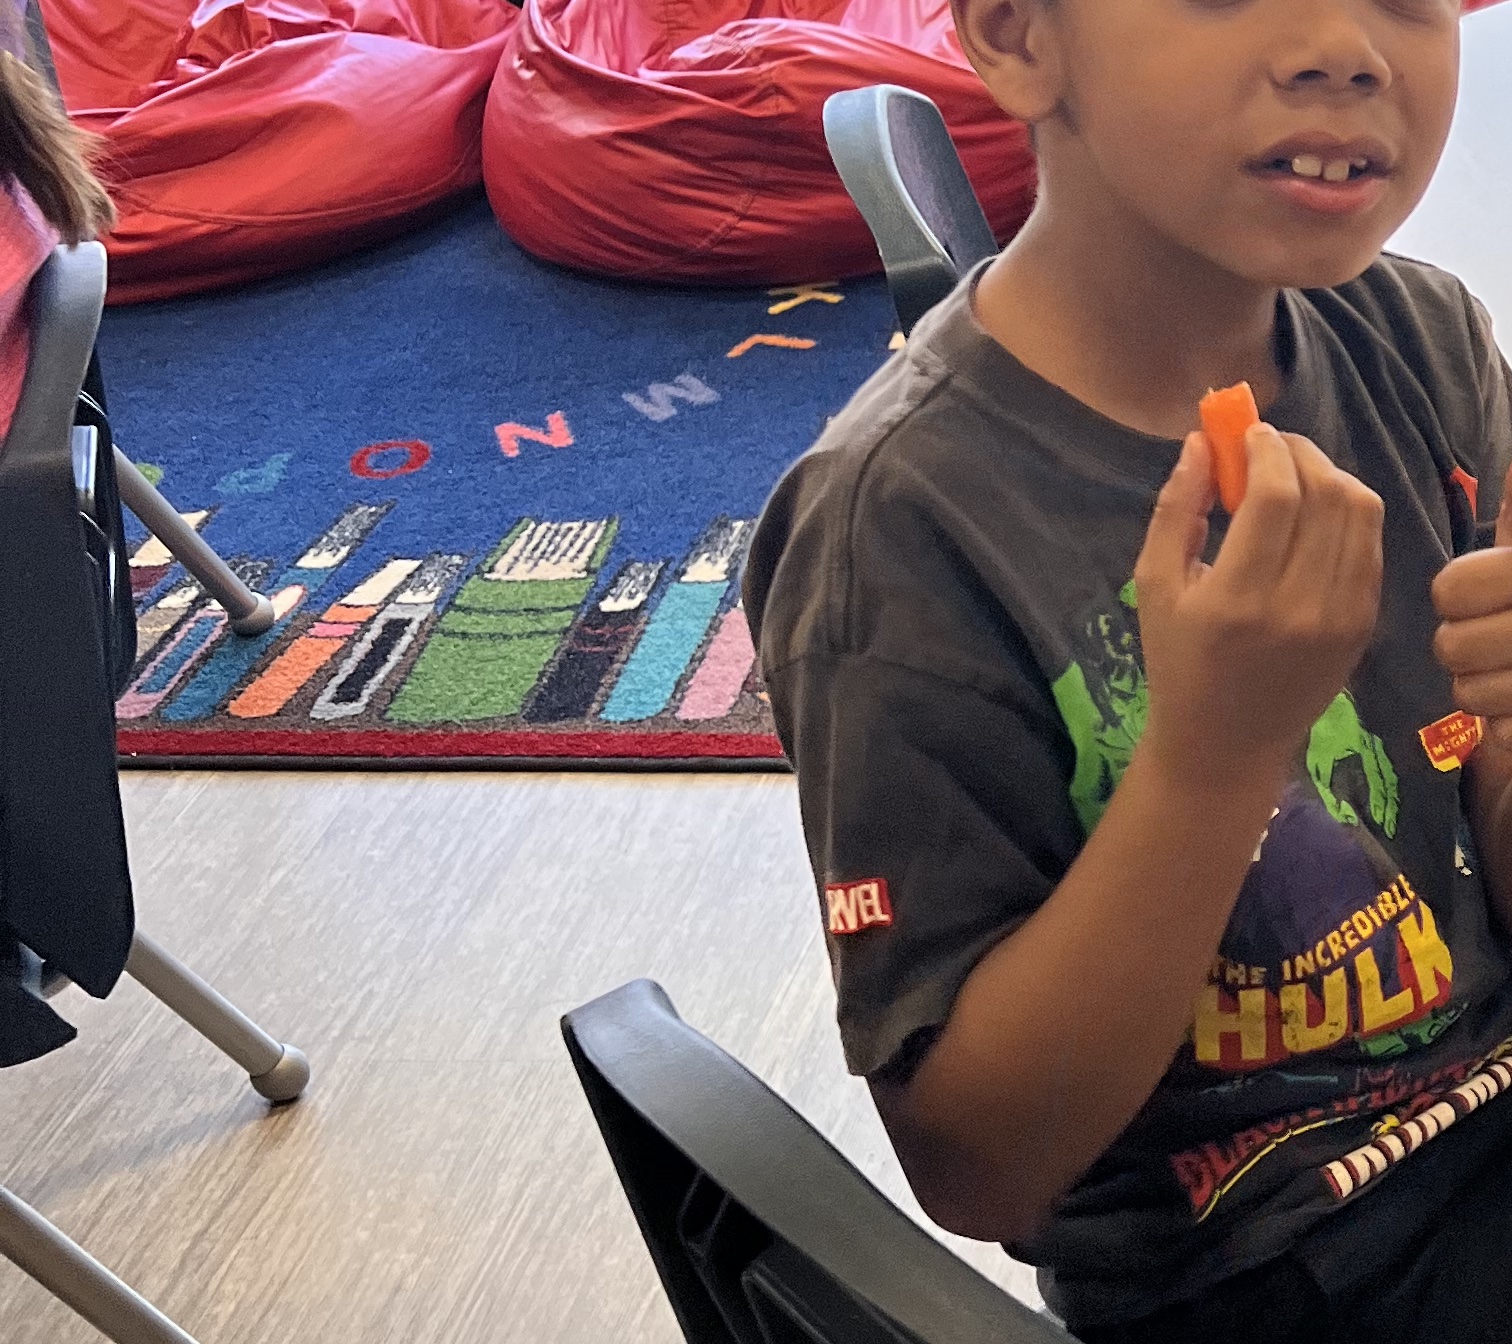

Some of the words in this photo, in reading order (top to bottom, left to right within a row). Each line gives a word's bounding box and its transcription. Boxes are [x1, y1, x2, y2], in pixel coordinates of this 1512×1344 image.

[826, 882, 890, 931] RVEL
[1208, 958, 1267, 985] THE
[1281, 874, 1416, 981] INCREDIBLE
[1195, 900, 1453, 1061] HULK
